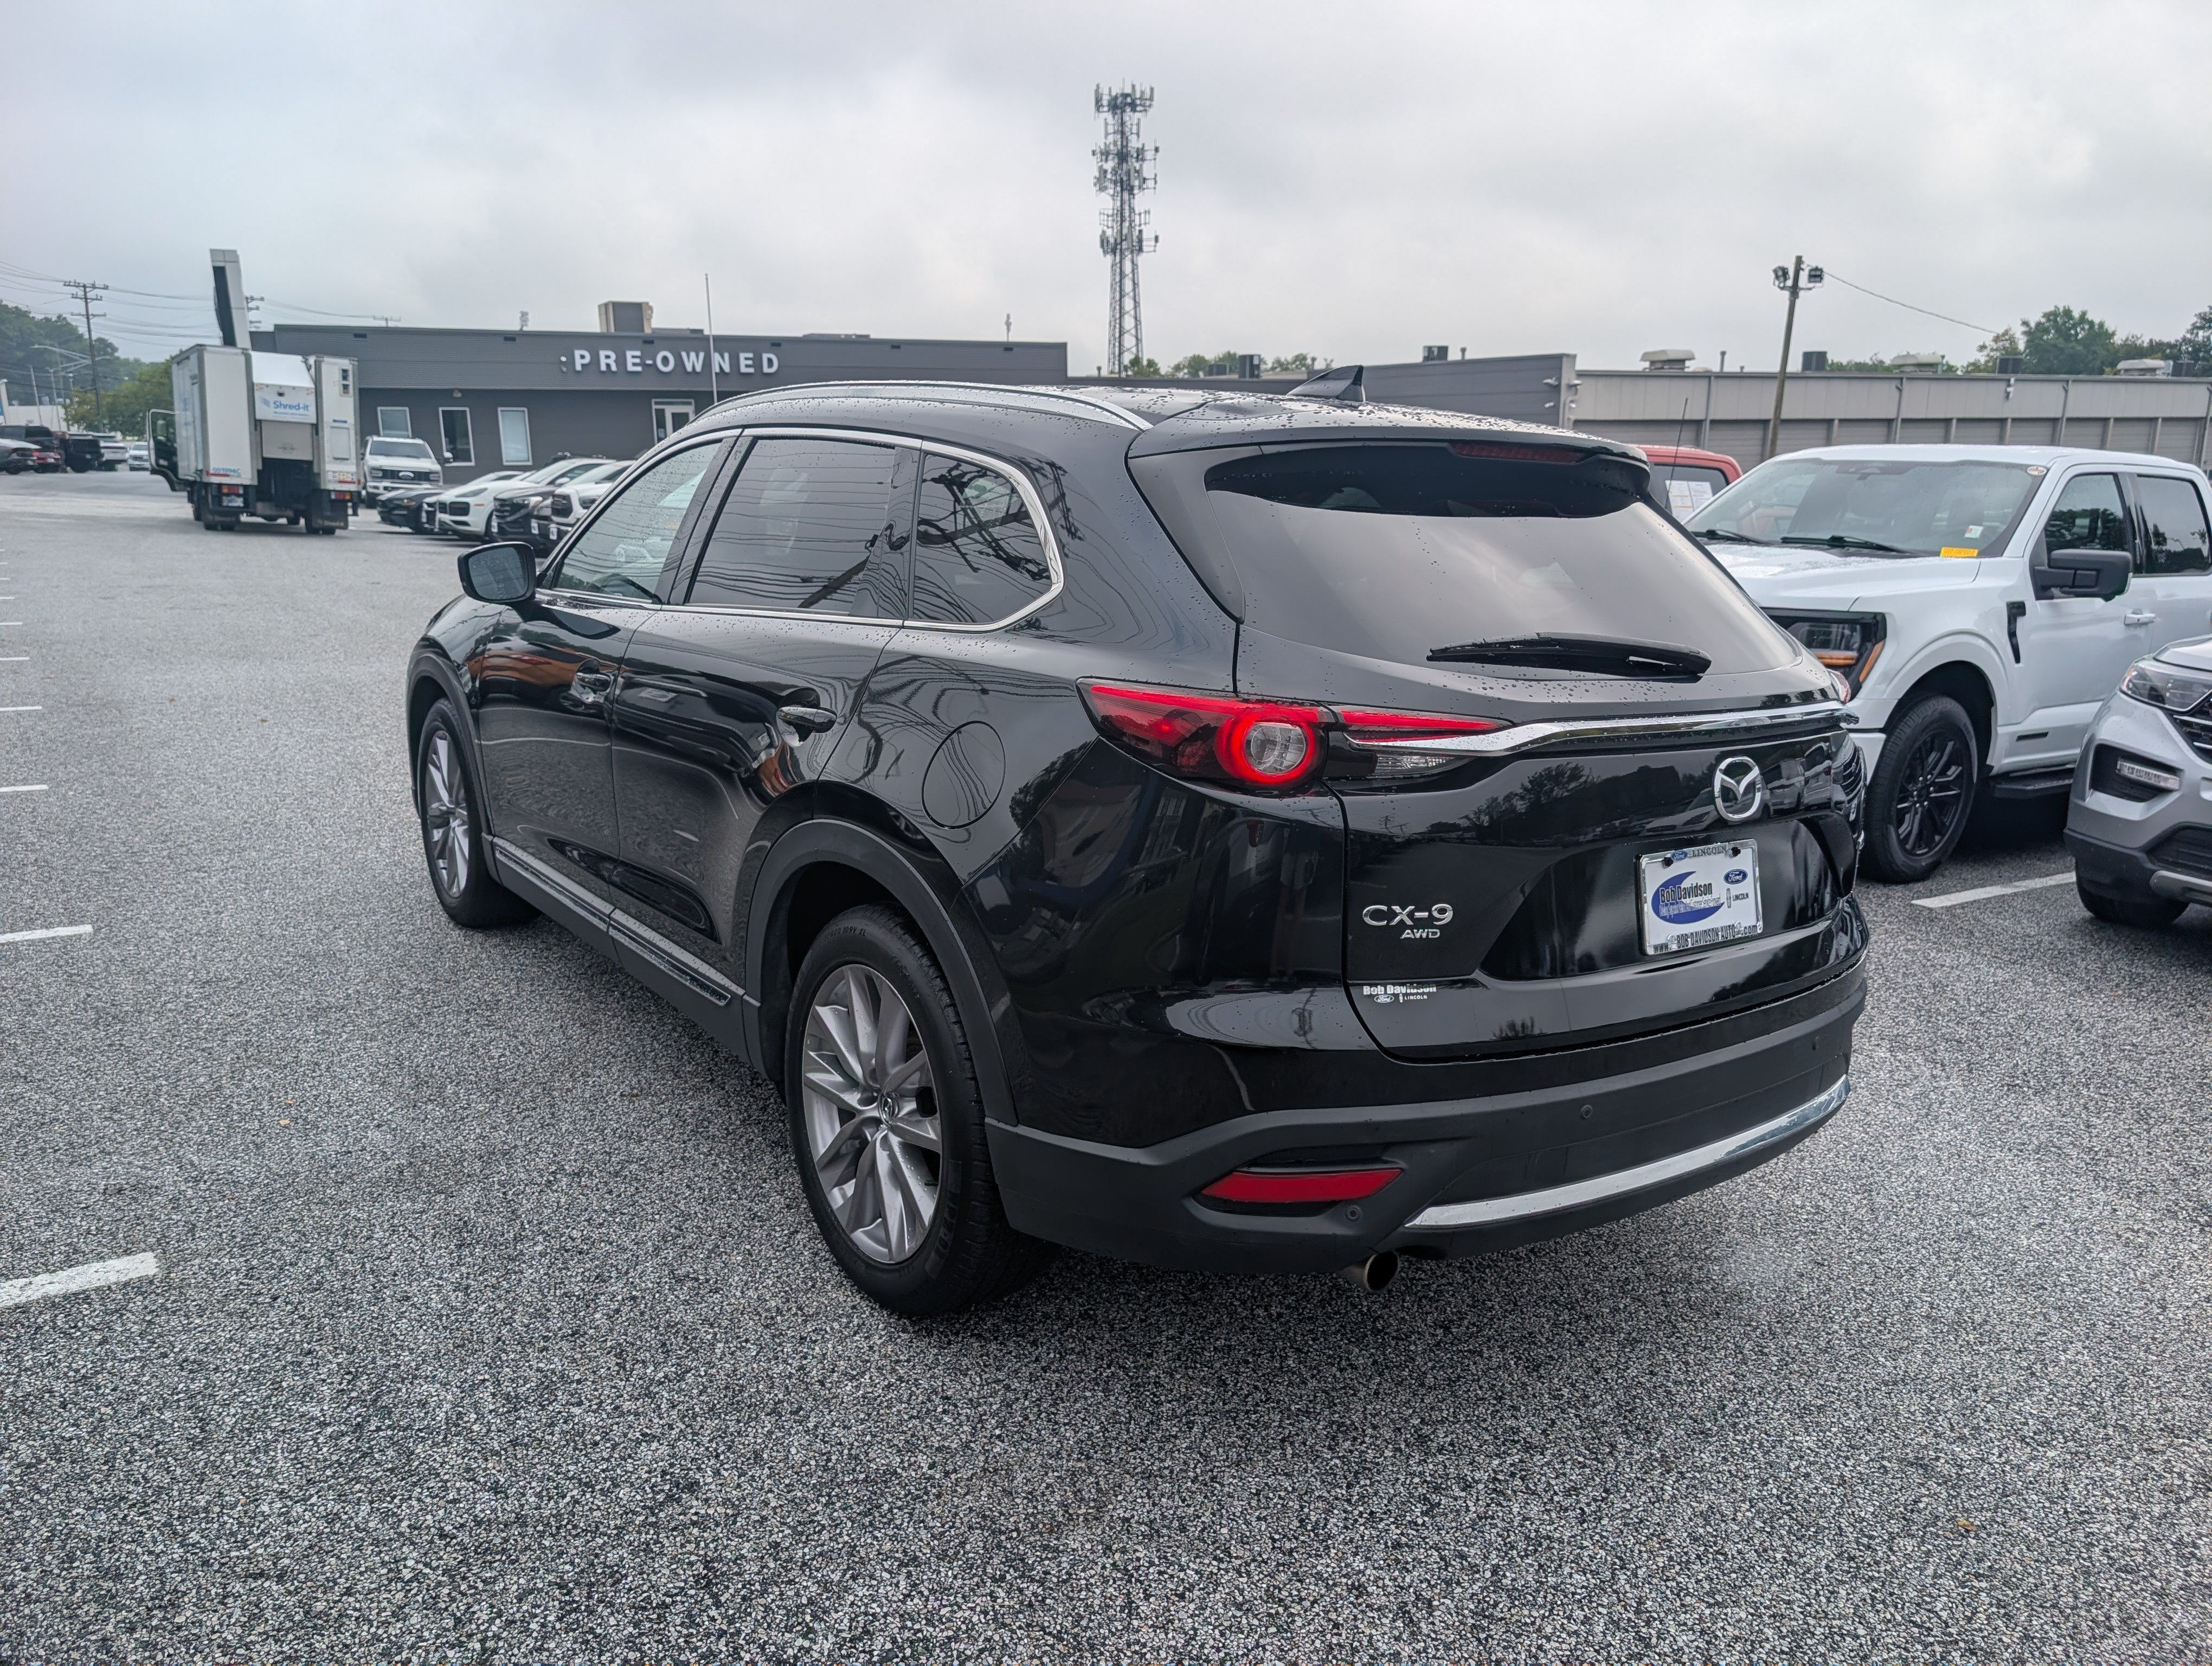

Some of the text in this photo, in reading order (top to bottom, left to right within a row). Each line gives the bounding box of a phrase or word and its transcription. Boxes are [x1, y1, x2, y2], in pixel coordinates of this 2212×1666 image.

[573, 349, 779, 374] PRE-OWNED
[273, 400, 309, 412] Shred-it
[1673, 845, 1727, 860] Ford LINCOLN
[1727, 870, 1744, 883] Ford
[1660, 886, 1675, 904] Bob
[1677, 882, 1713, 900] Davidson
[1732, 892, 1749, 901] LINCOLN
[1362, 904, 1454, 926] CX-9
[1400, 929, 1441, 939] AWD
[1677, 933, 1689, 949] BOB
[1690, 927, 1719, 946] DAVIDSON
[1721, 924, 1735, 940] AUTO
[1363, 984, 1437, 995] Bob Davidson
[1377, 995, 1392, 1003] Ford
